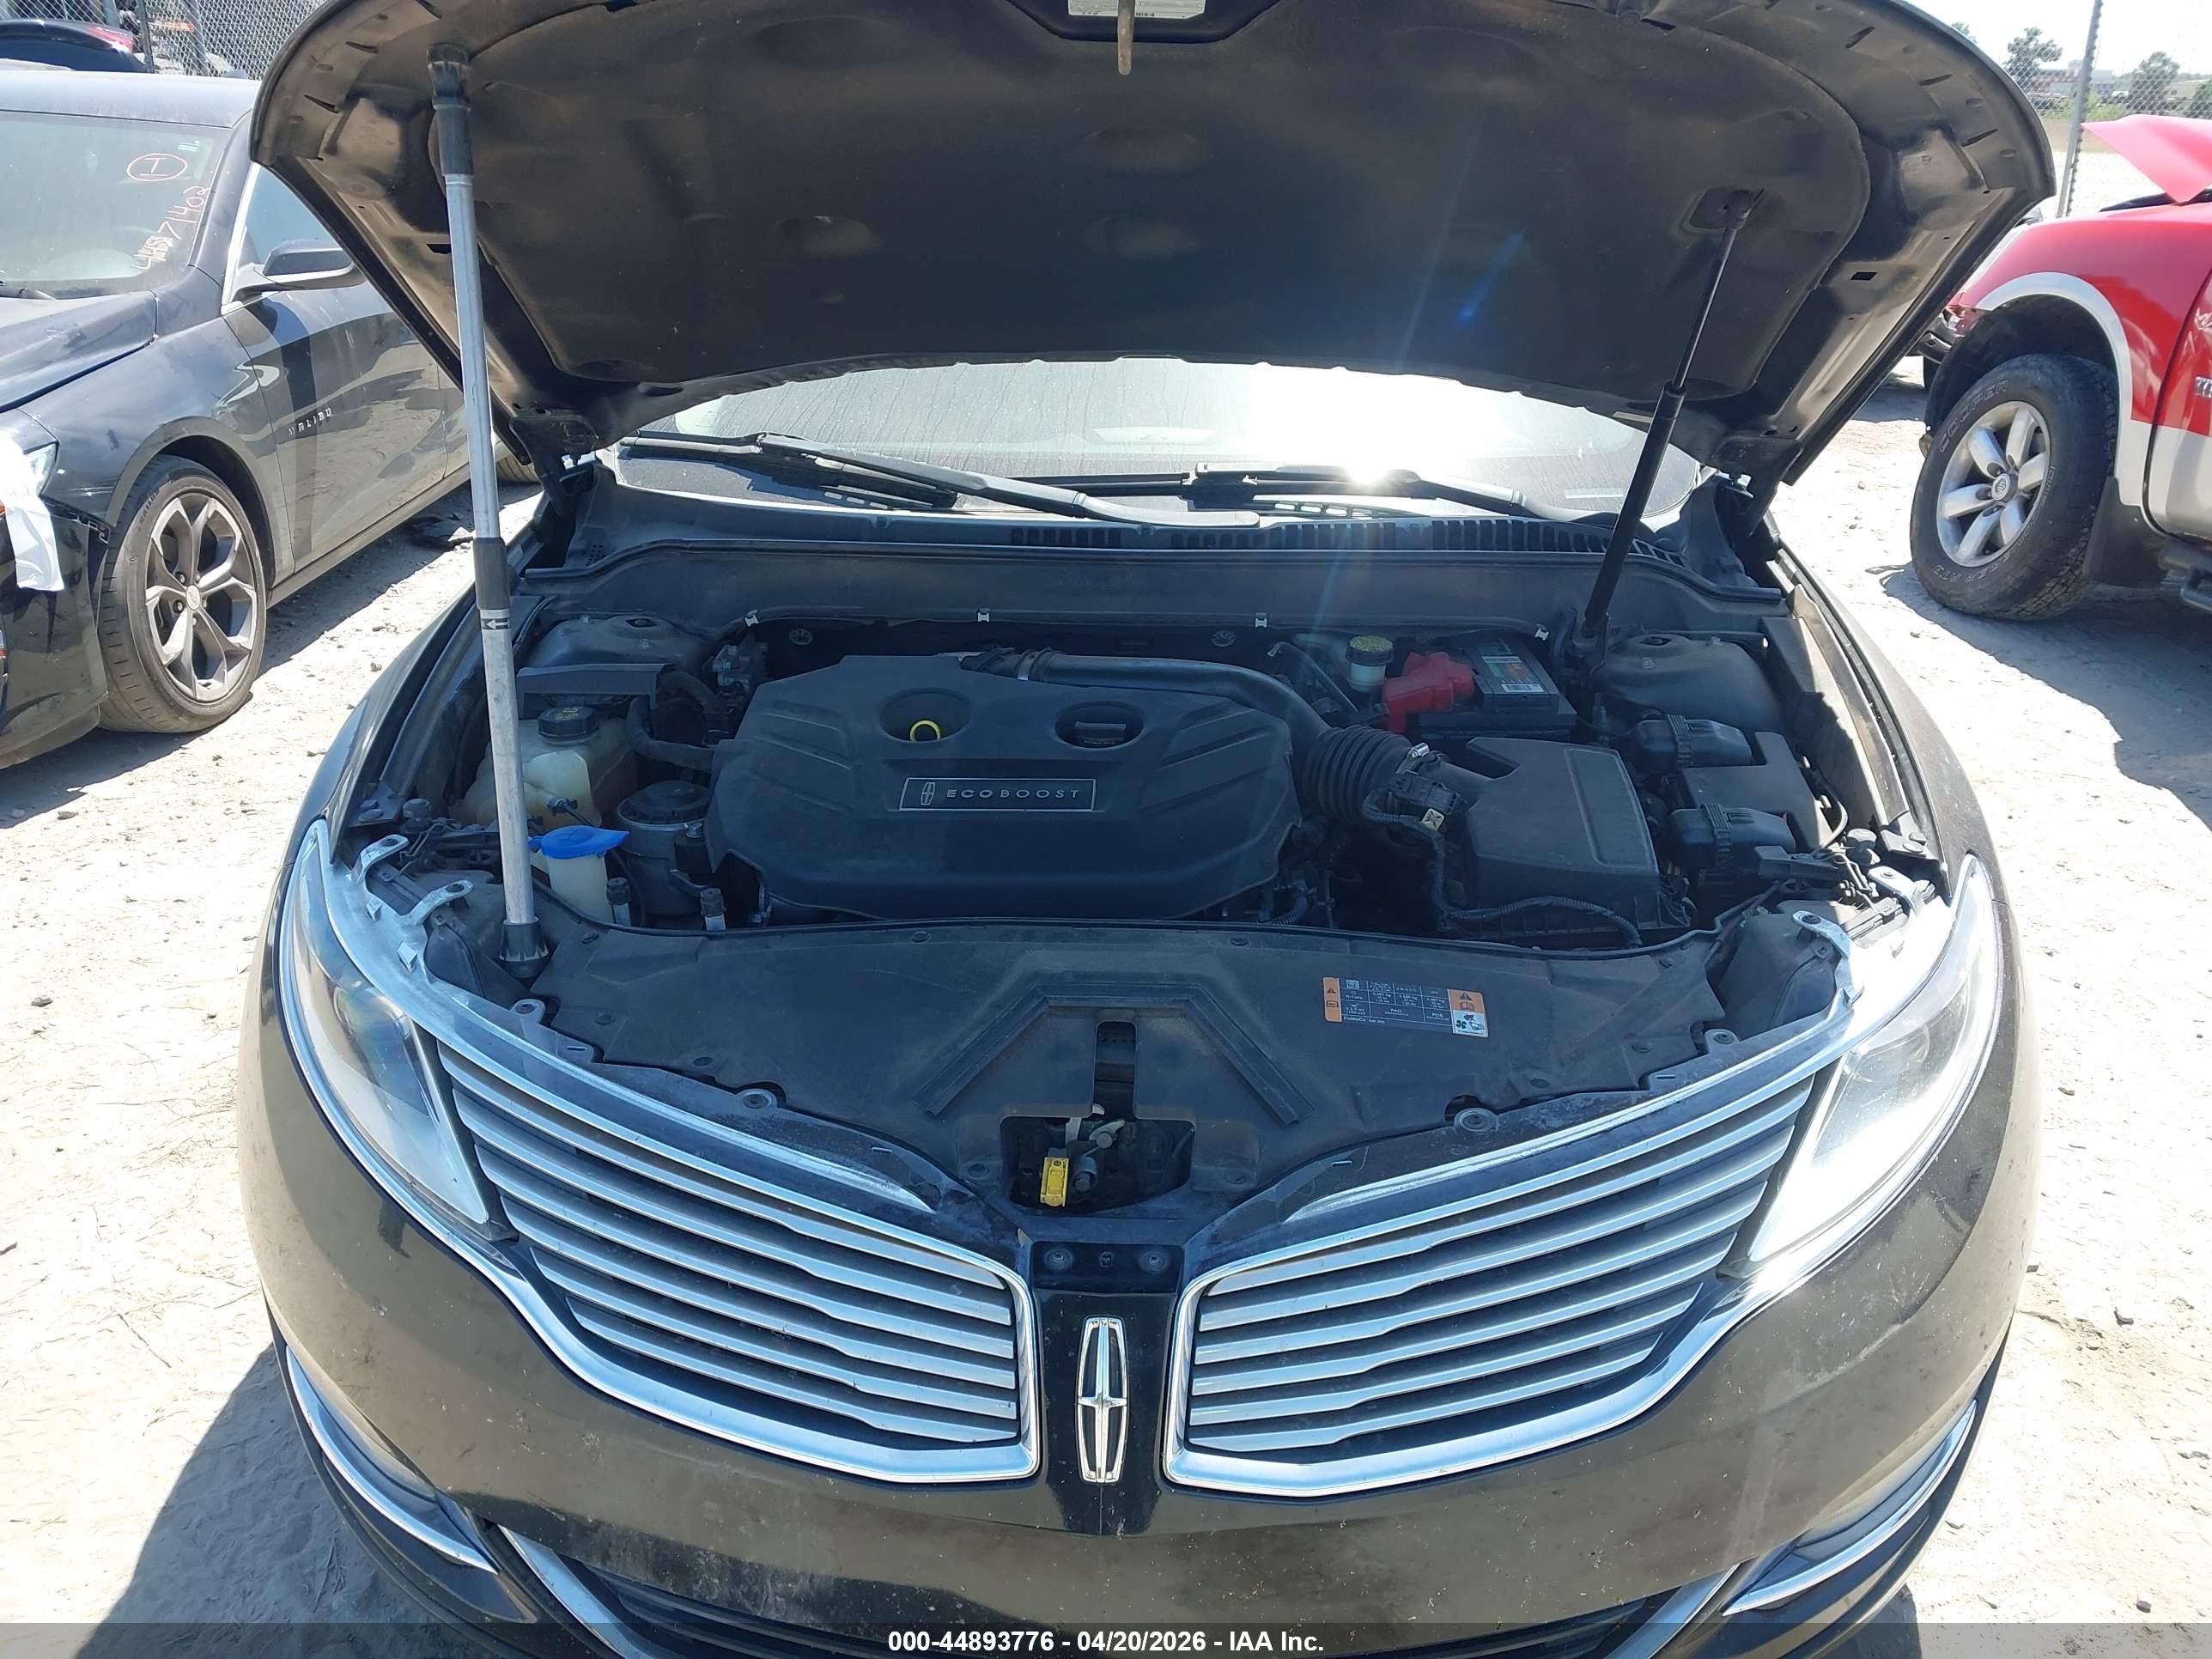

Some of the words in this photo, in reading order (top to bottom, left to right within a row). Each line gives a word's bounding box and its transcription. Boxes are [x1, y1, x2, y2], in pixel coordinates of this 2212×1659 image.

[288, 407, 331, 439] MALIBU
[1940, 380, 2009, 453] COOPER
[946, 789, 1079, 799] ECOBOOST
